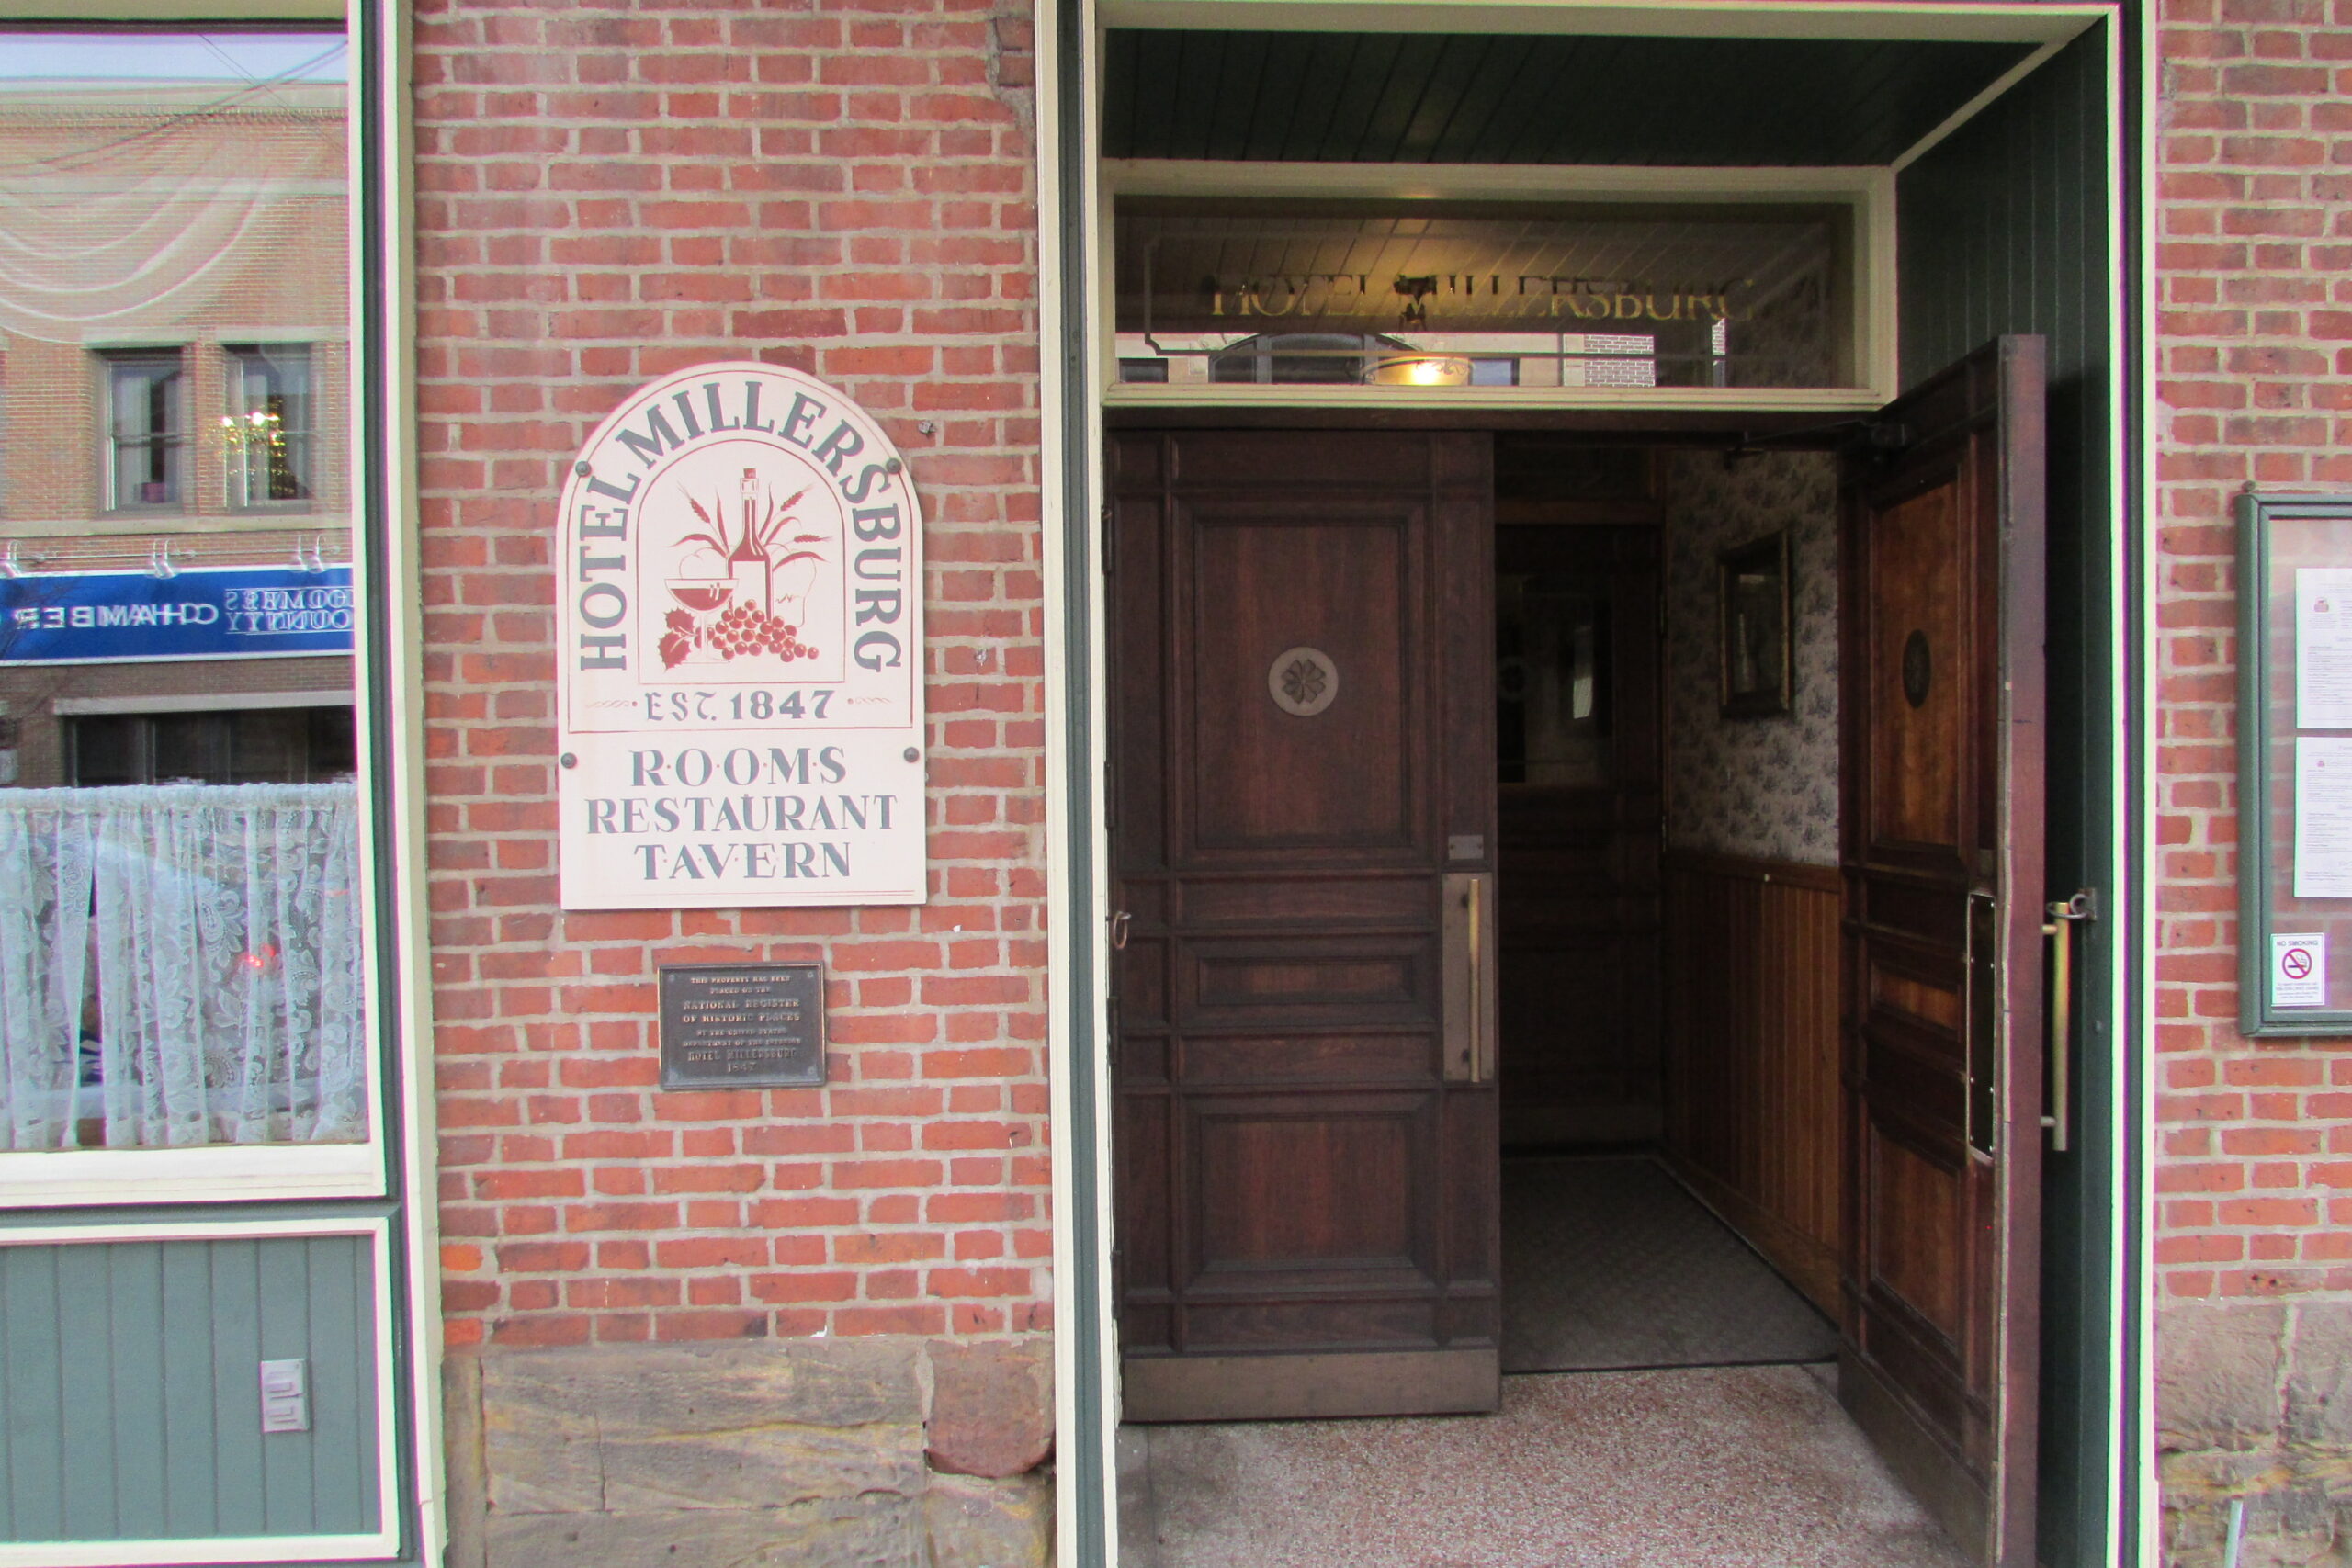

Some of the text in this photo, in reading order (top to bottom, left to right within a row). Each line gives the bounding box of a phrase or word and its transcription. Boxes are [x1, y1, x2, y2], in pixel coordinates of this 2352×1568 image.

[1209, 274, 1366, 316] HOTEL
[579, 380, 903, 673] HOTEL MILLERSBURG
[645, 689, 835, 721] EST. 1847
[631, 746, 846, 787] ROOMS
[585, 795, 898, 834] RESTAURANT
[634, 841, 851, 881] TAVERN
[683, 1012, 800, 1023] OF HISTORIC PLACES
[684, 998, 799, 1010] NATIONAL REGISTER
[687, 1047, 797, 1061] HOTEL MILLERSBURG
